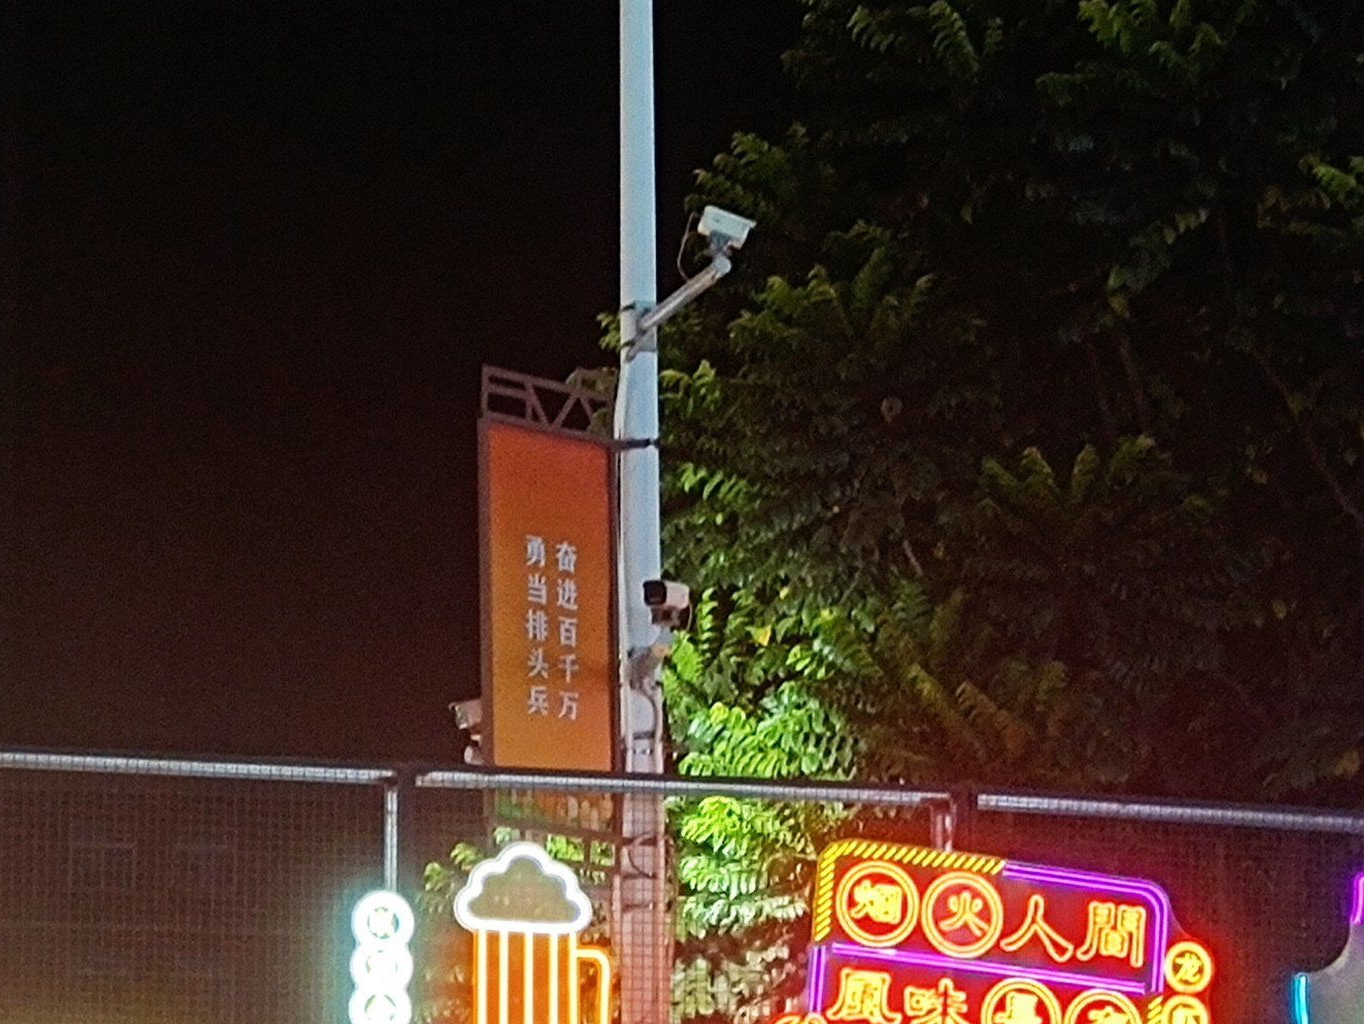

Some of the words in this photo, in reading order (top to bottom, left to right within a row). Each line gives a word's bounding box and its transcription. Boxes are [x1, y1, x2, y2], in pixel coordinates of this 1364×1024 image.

[523, 535, 548, 717] 勇当排头兵
[555, 542, 579, 722] 奋进百千万
